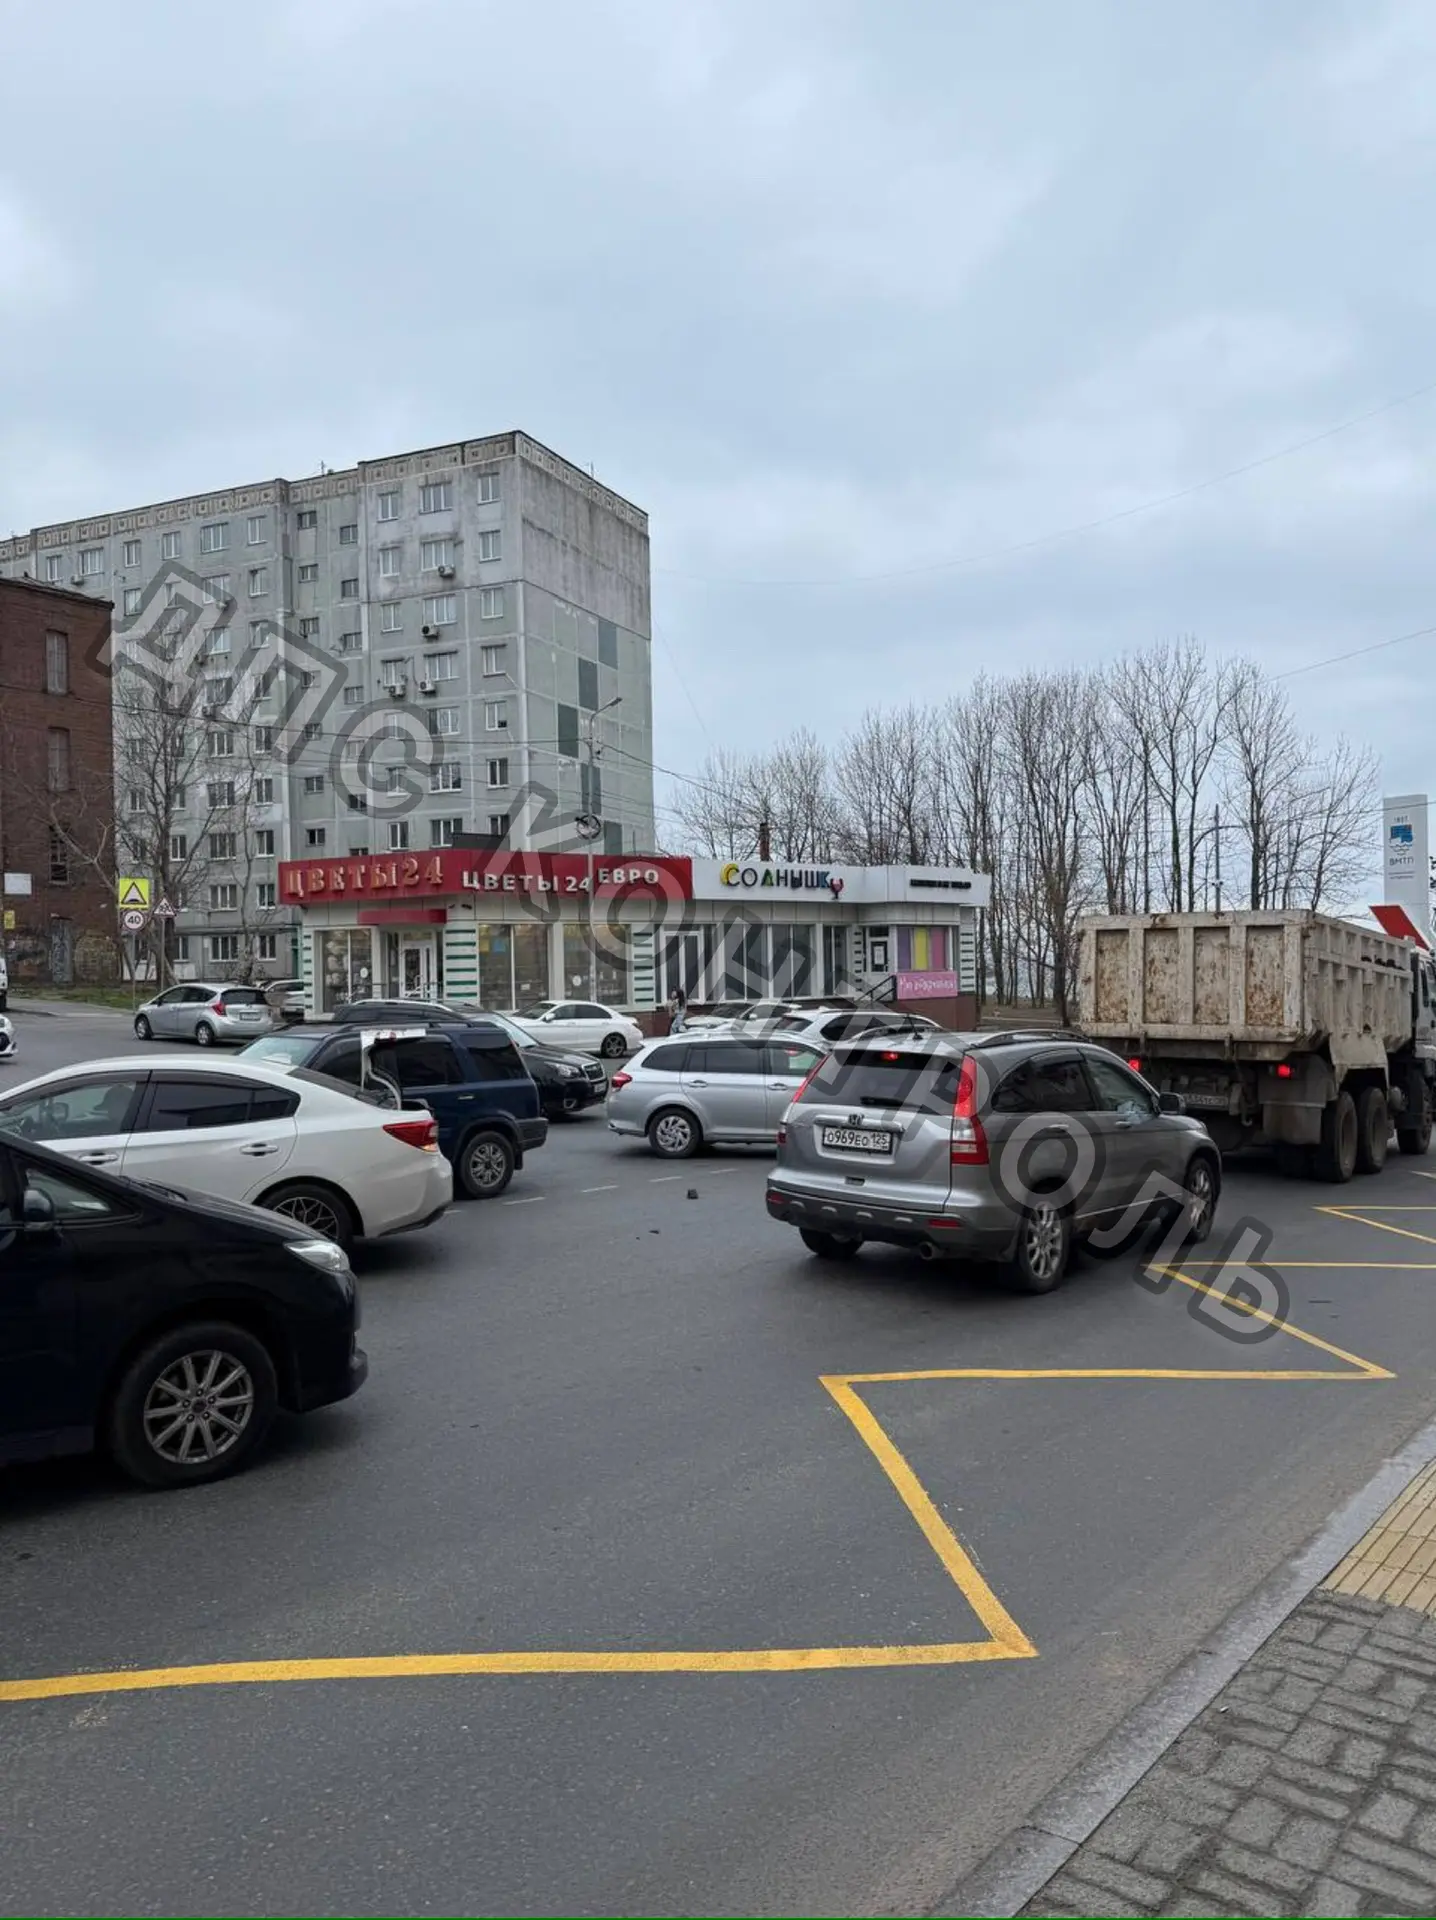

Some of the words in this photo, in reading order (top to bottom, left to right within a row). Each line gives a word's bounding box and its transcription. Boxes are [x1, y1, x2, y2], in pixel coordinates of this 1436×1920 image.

[462, 870, 559, 893] ЦВЕТЫ
[565, 876, 593, 893] 24
[598, 867, 660, 885] ЕВРО
[127, 914, 142, 924] 40
